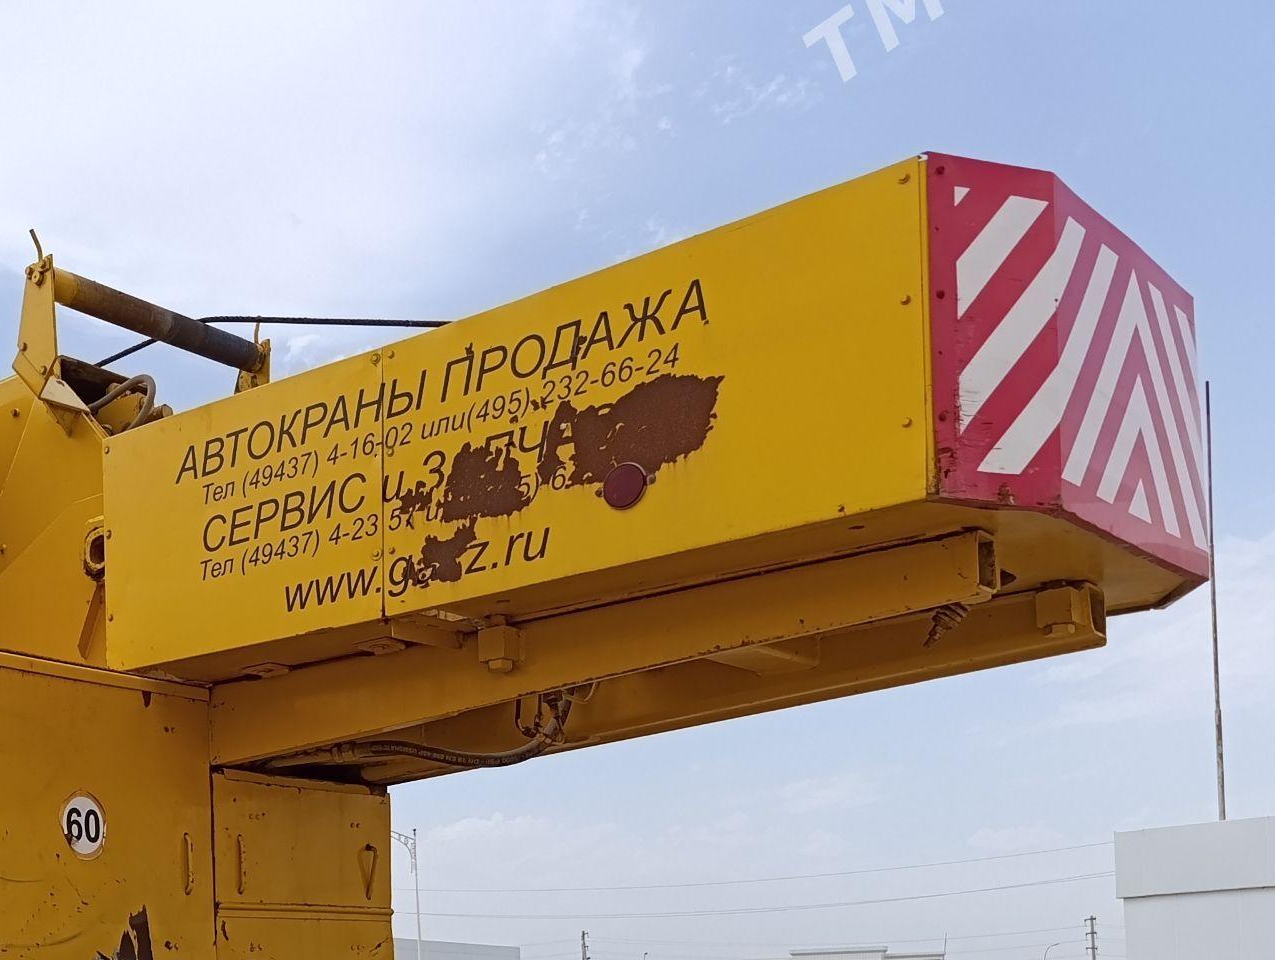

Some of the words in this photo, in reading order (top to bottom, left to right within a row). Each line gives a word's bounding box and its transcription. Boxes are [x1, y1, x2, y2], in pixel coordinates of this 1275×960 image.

[175, 369, 427, 485] АВТОКРАНЫ
[440, 279, 709, 403] ПРОДАЖА
[202, 481, 235, 505] Тел
[243, 450, 319, 498] (49437)
[326, 422, 413, 466] 4-16-02
[542, 342, 680, 404] 232-66-24
[202, 472, 367, 553] СЕРВИС
[200, 557, 234, 581] Тел
[241, 529, 320, 576] (49437)
[66, 807, 101, 844] 60
